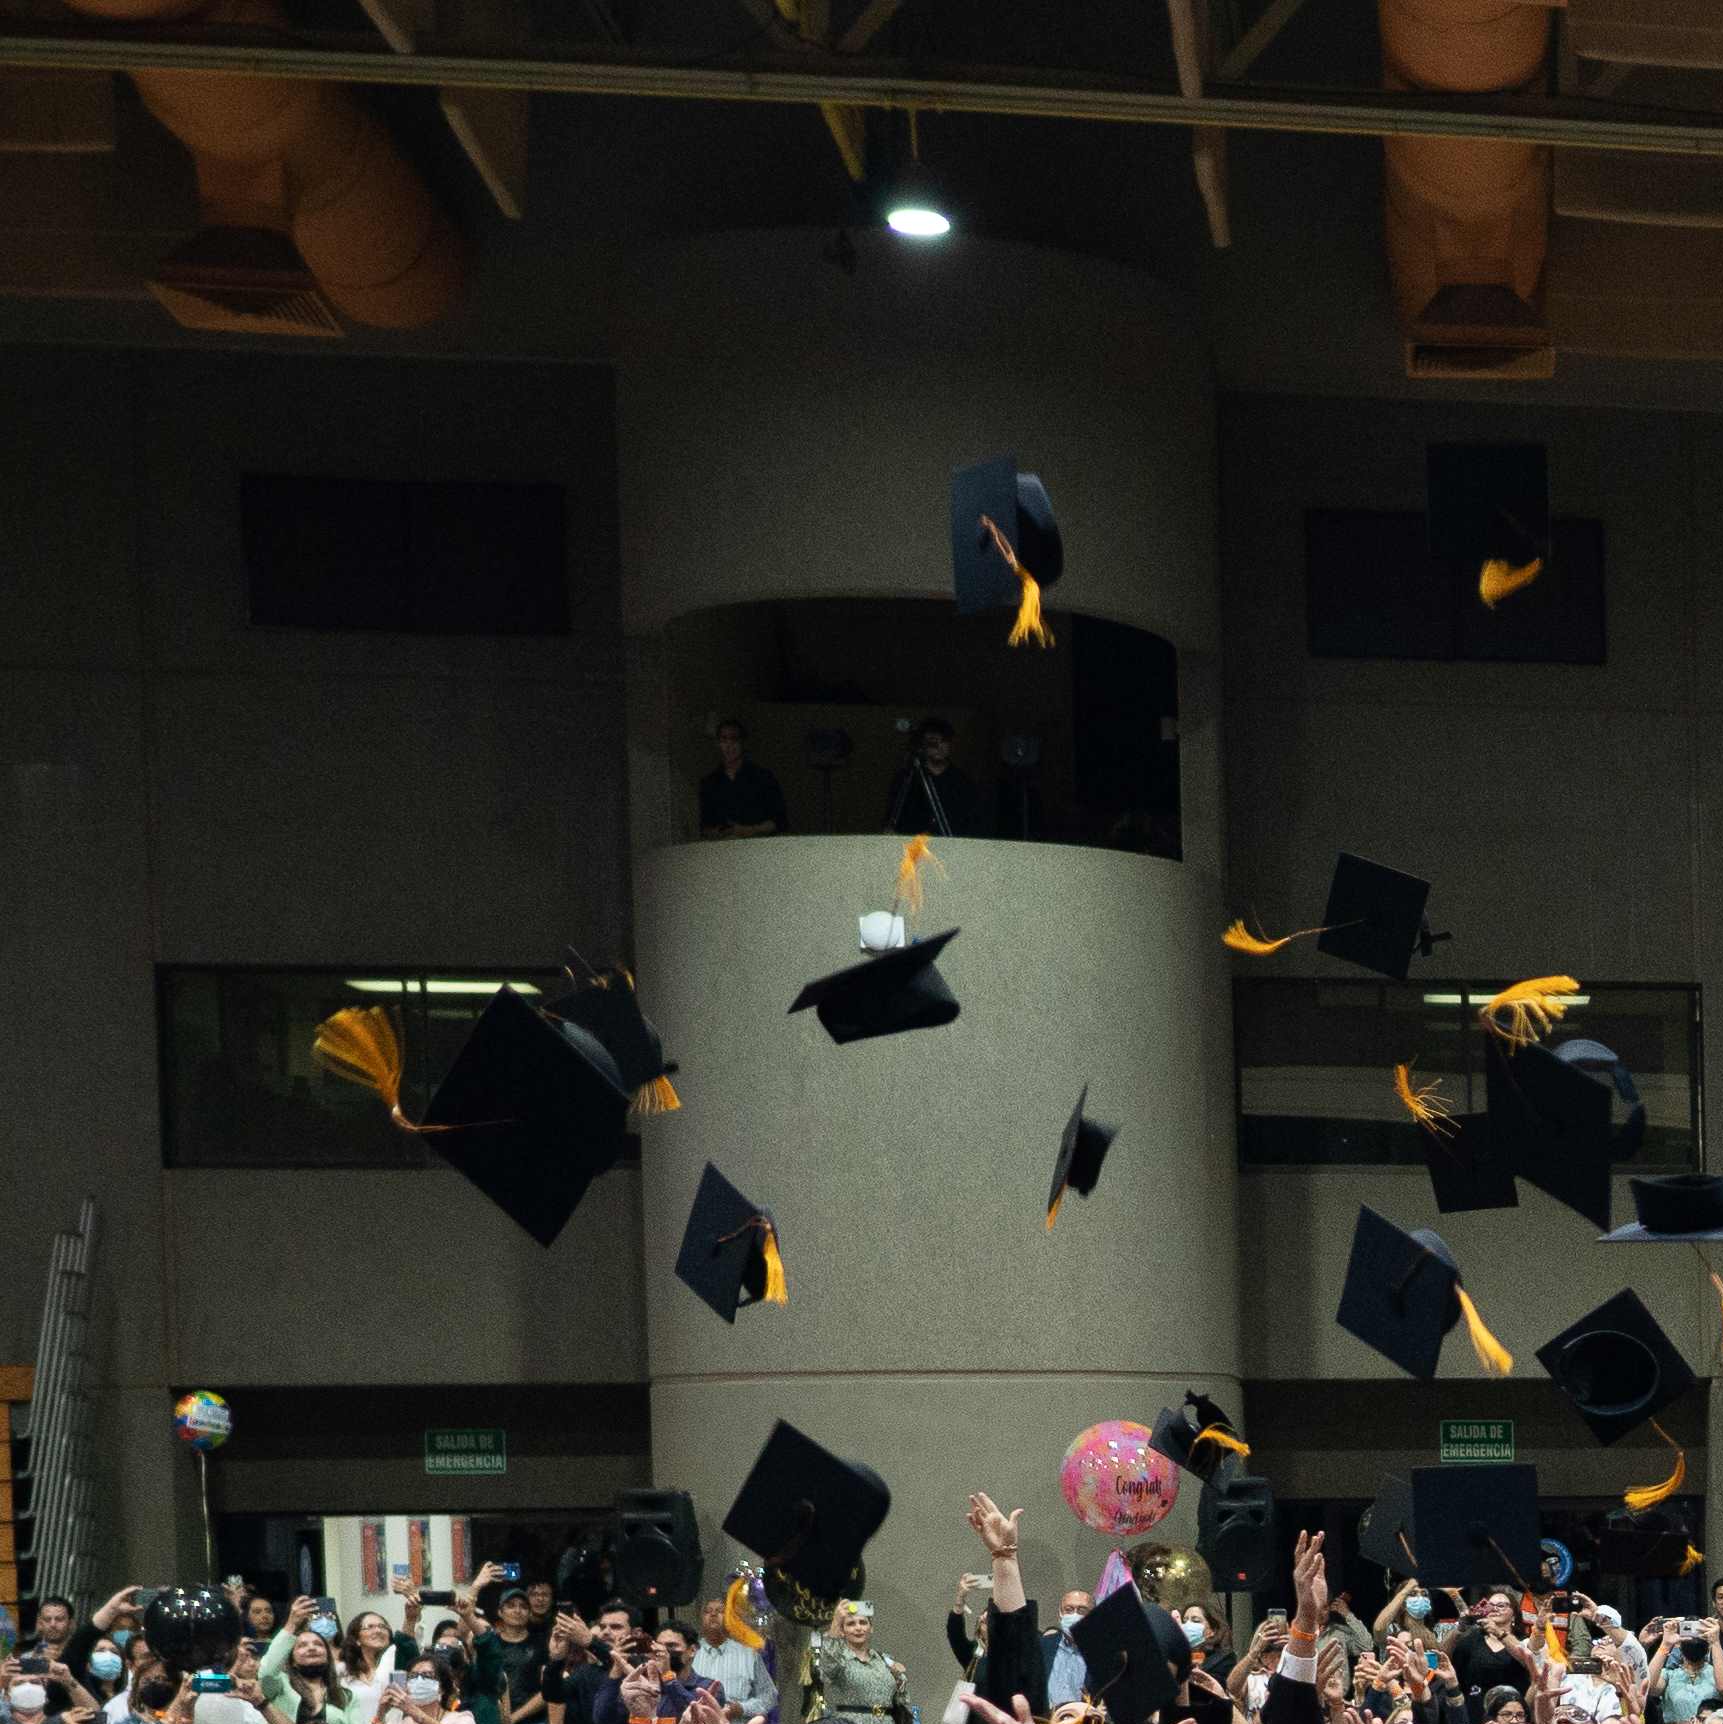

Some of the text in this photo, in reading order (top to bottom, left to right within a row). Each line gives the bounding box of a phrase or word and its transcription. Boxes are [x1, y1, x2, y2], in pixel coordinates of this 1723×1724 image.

[1450, 1425, 1504, 1439] SALIDA DE
[435, 1434, 494, 1449] SALIDA DE
[1443, 1443, 1512, 1457] EMERGENCIA
[428, 1454, 502, 1469] EMERGENCIA
[1115, 1475, 1162, 1502] Congrats
